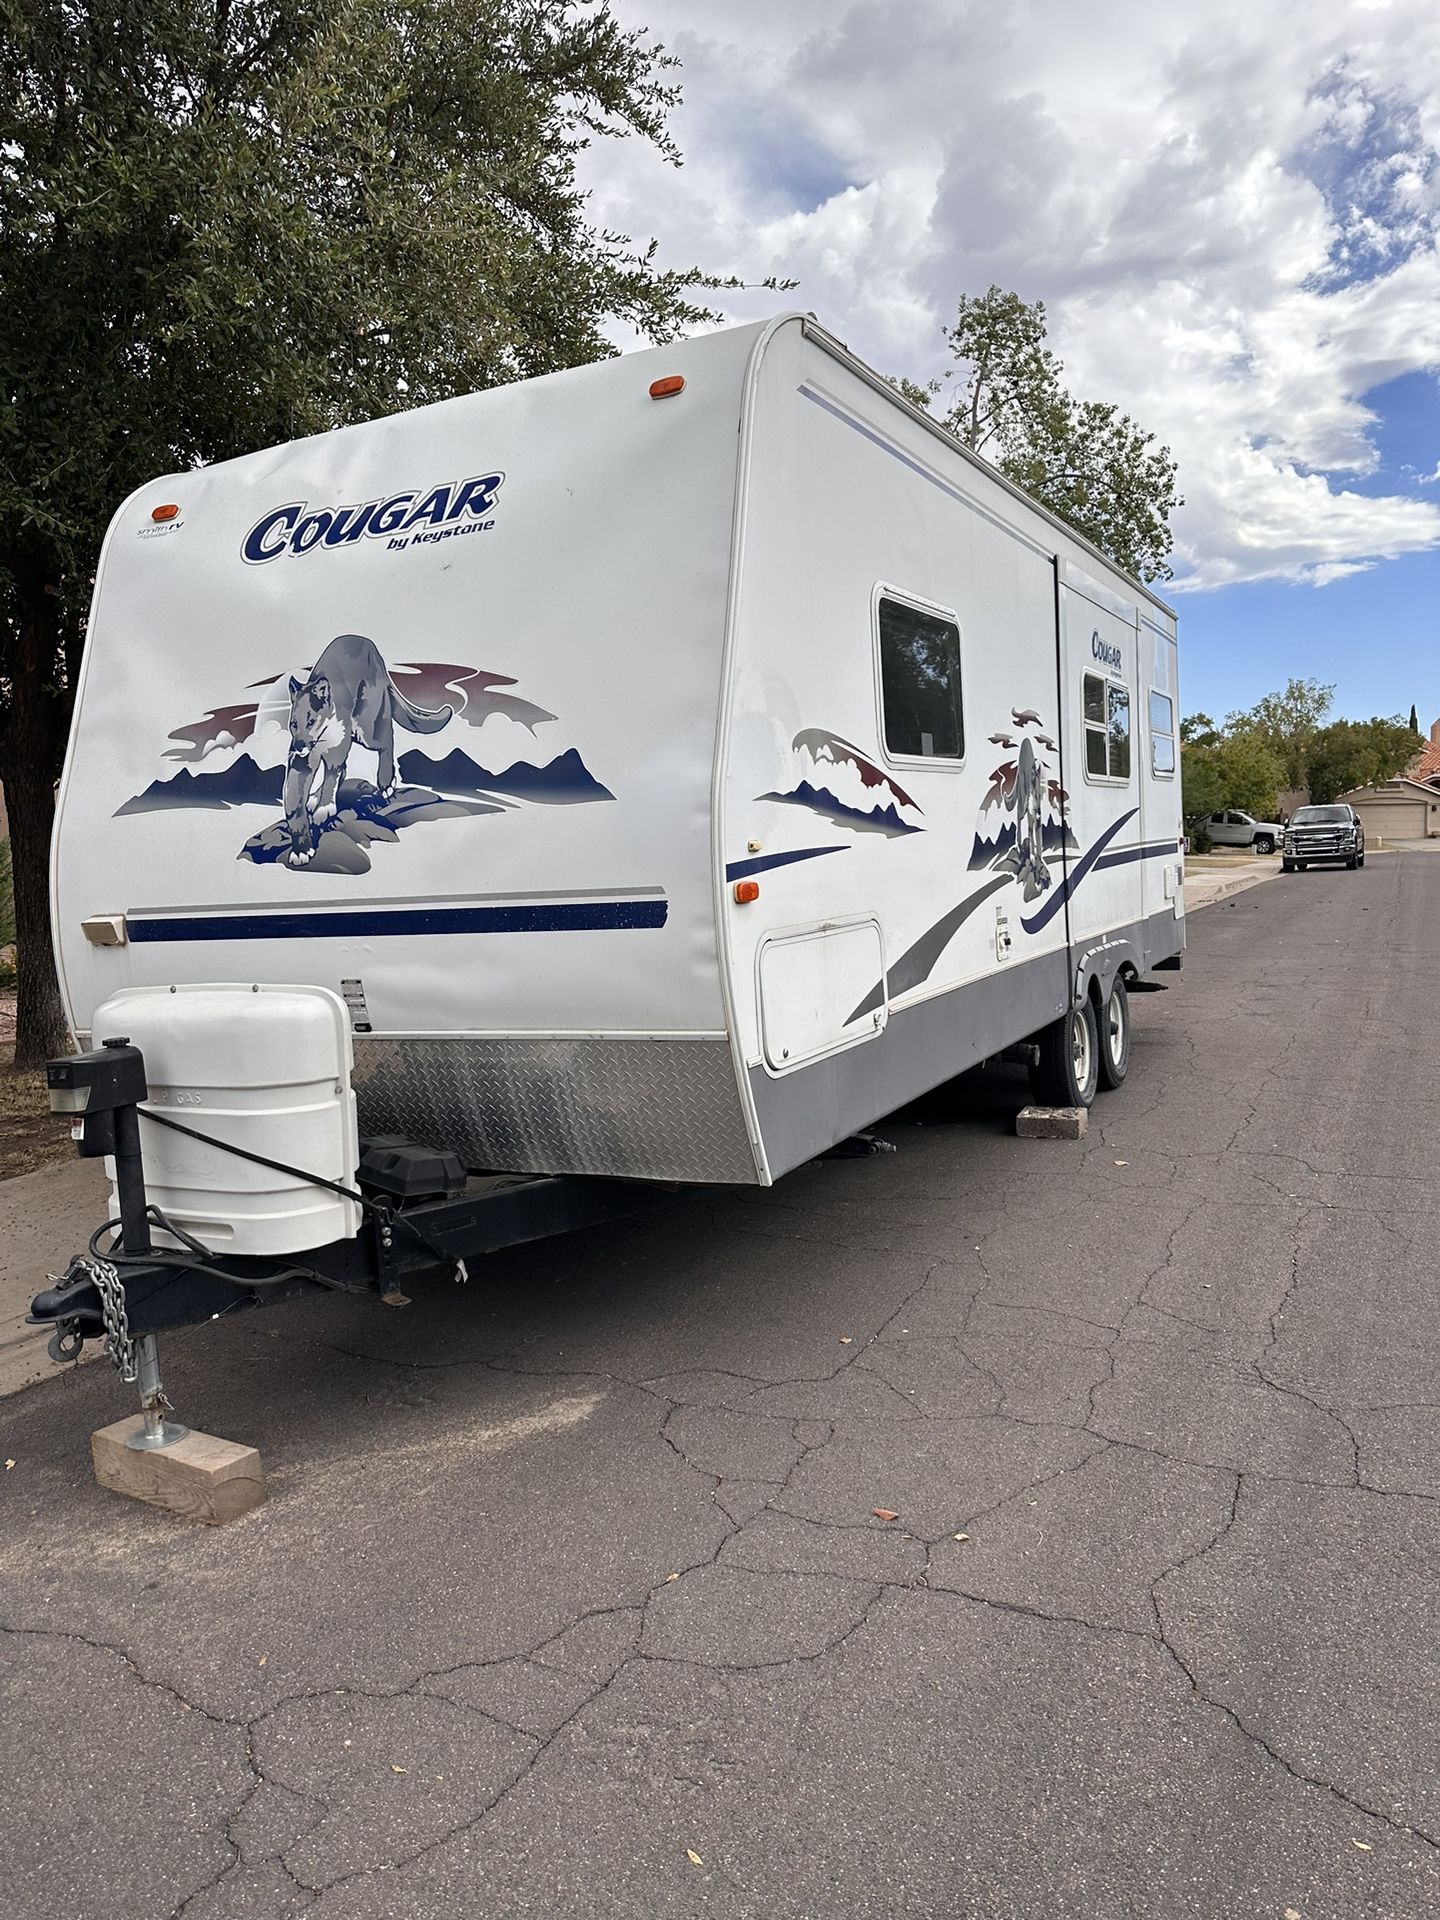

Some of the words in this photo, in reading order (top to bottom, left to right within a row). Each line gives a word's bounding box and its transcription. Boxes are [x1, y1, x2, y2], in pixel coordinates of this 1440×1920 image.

[243, 474, 502, 562] COUGAR
[386, 536, 407, 550] by
[413, 519, 496, 546] Keystone
[176, 1091, 202, 1105] GAS
